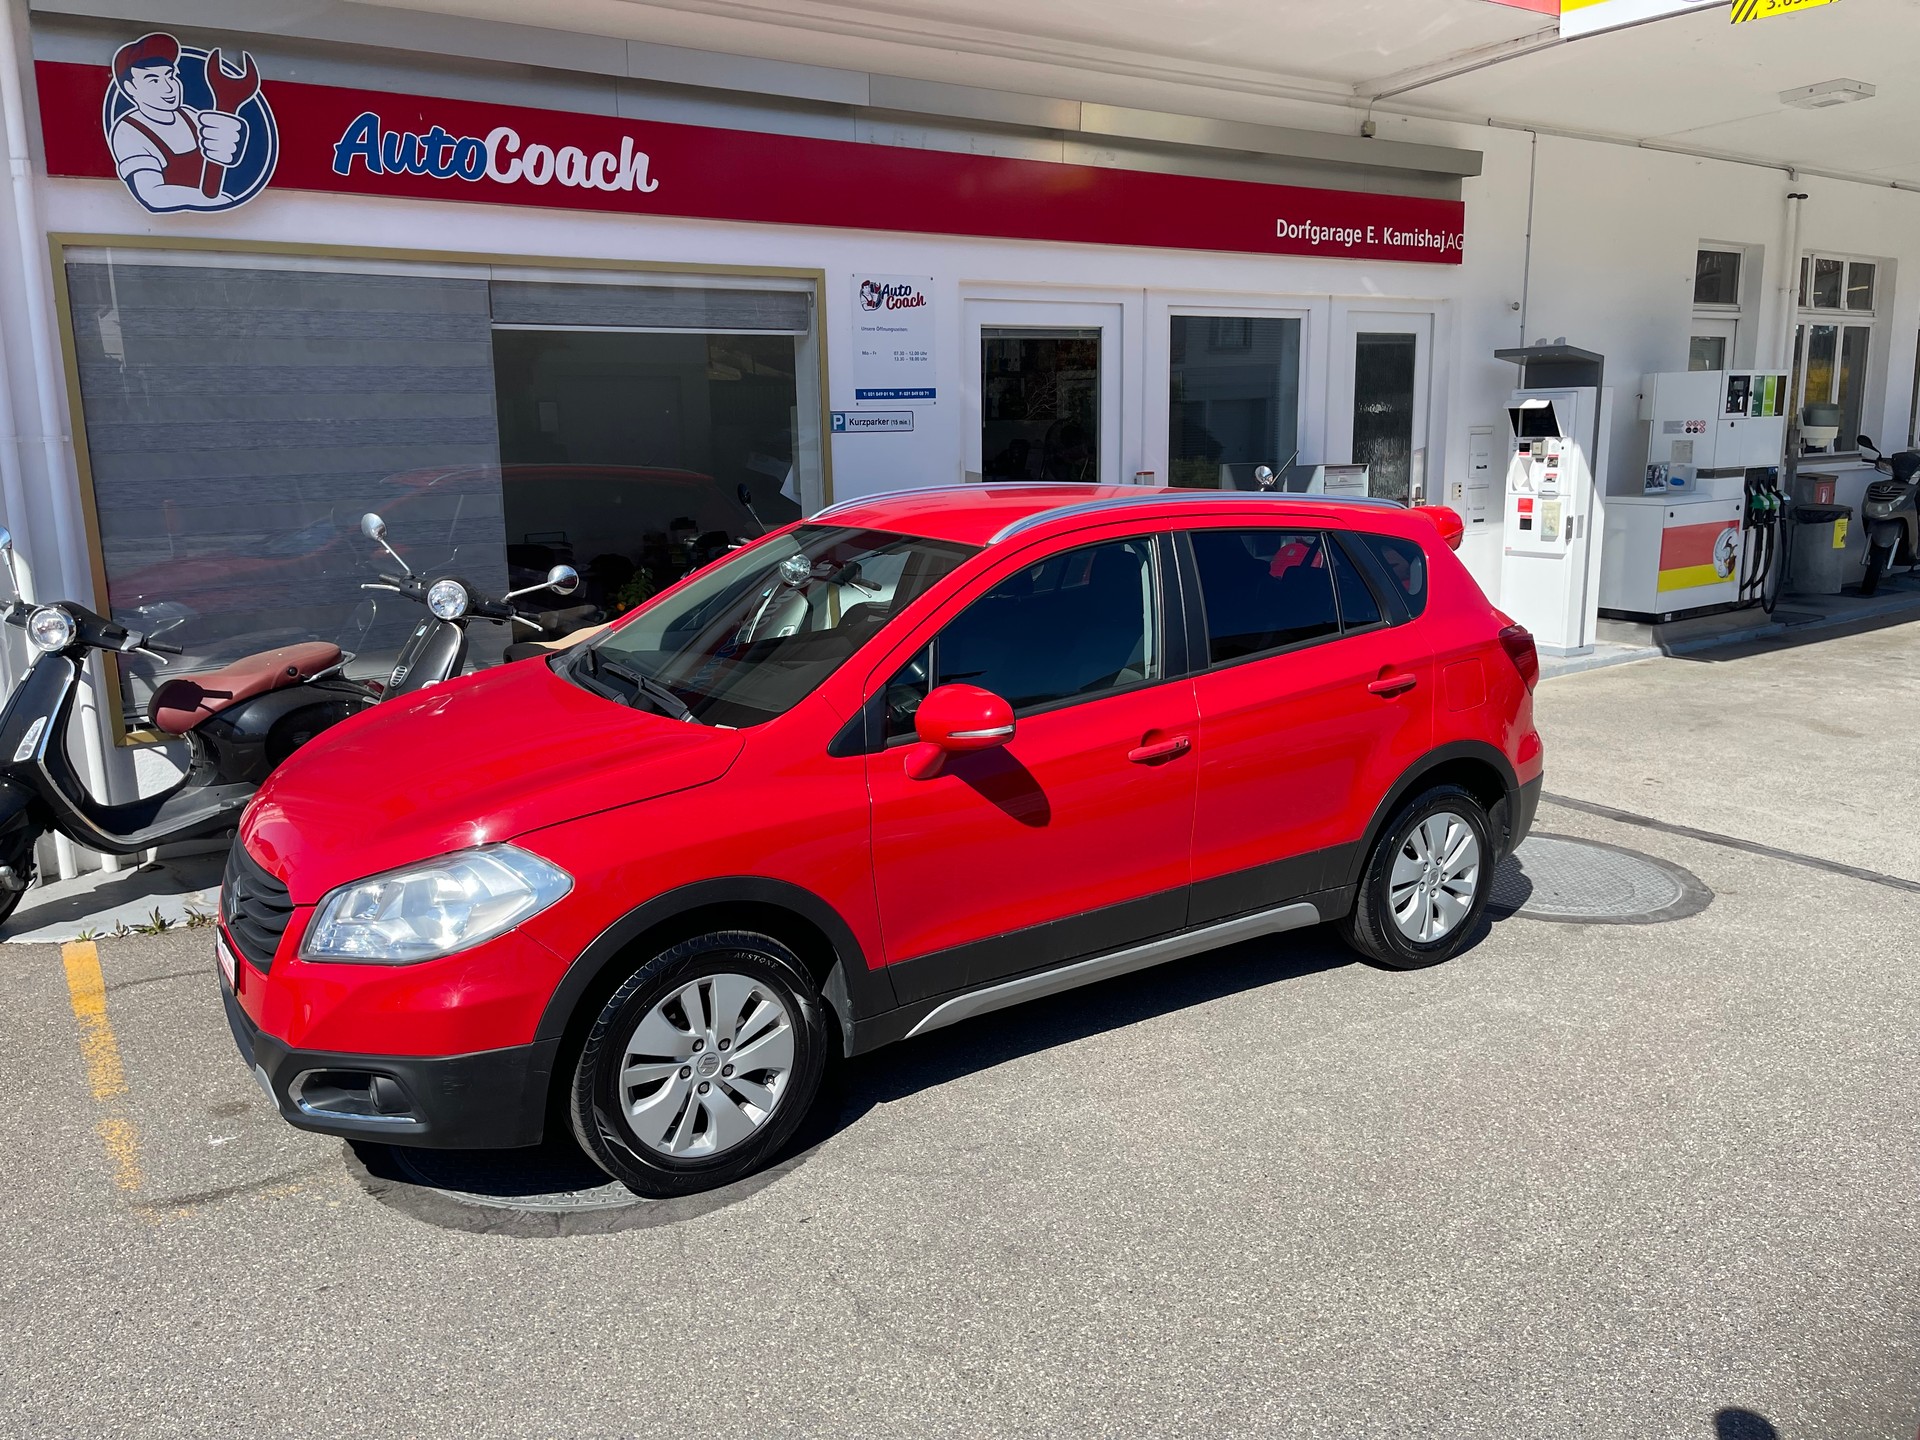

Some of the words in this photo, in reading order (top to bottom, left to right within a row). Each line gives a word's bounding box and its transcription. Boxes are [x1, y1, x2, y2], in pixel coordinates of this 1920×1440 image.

[1276, 218, 1362, 247] Dorfgarage
[1367, 226, 1378, 244] E.
[1383, 227, 1445, 253] Kamishaj
[881, 283, 912, 300] Auto
[886, 291, 927, 311] Coach
[1738, 396, 1743, 410] 1
[833, 414, 844, 430] P
[849, 418, 889, 428] Kurzparker
[734, 952, 779, 969] AUSTONE
